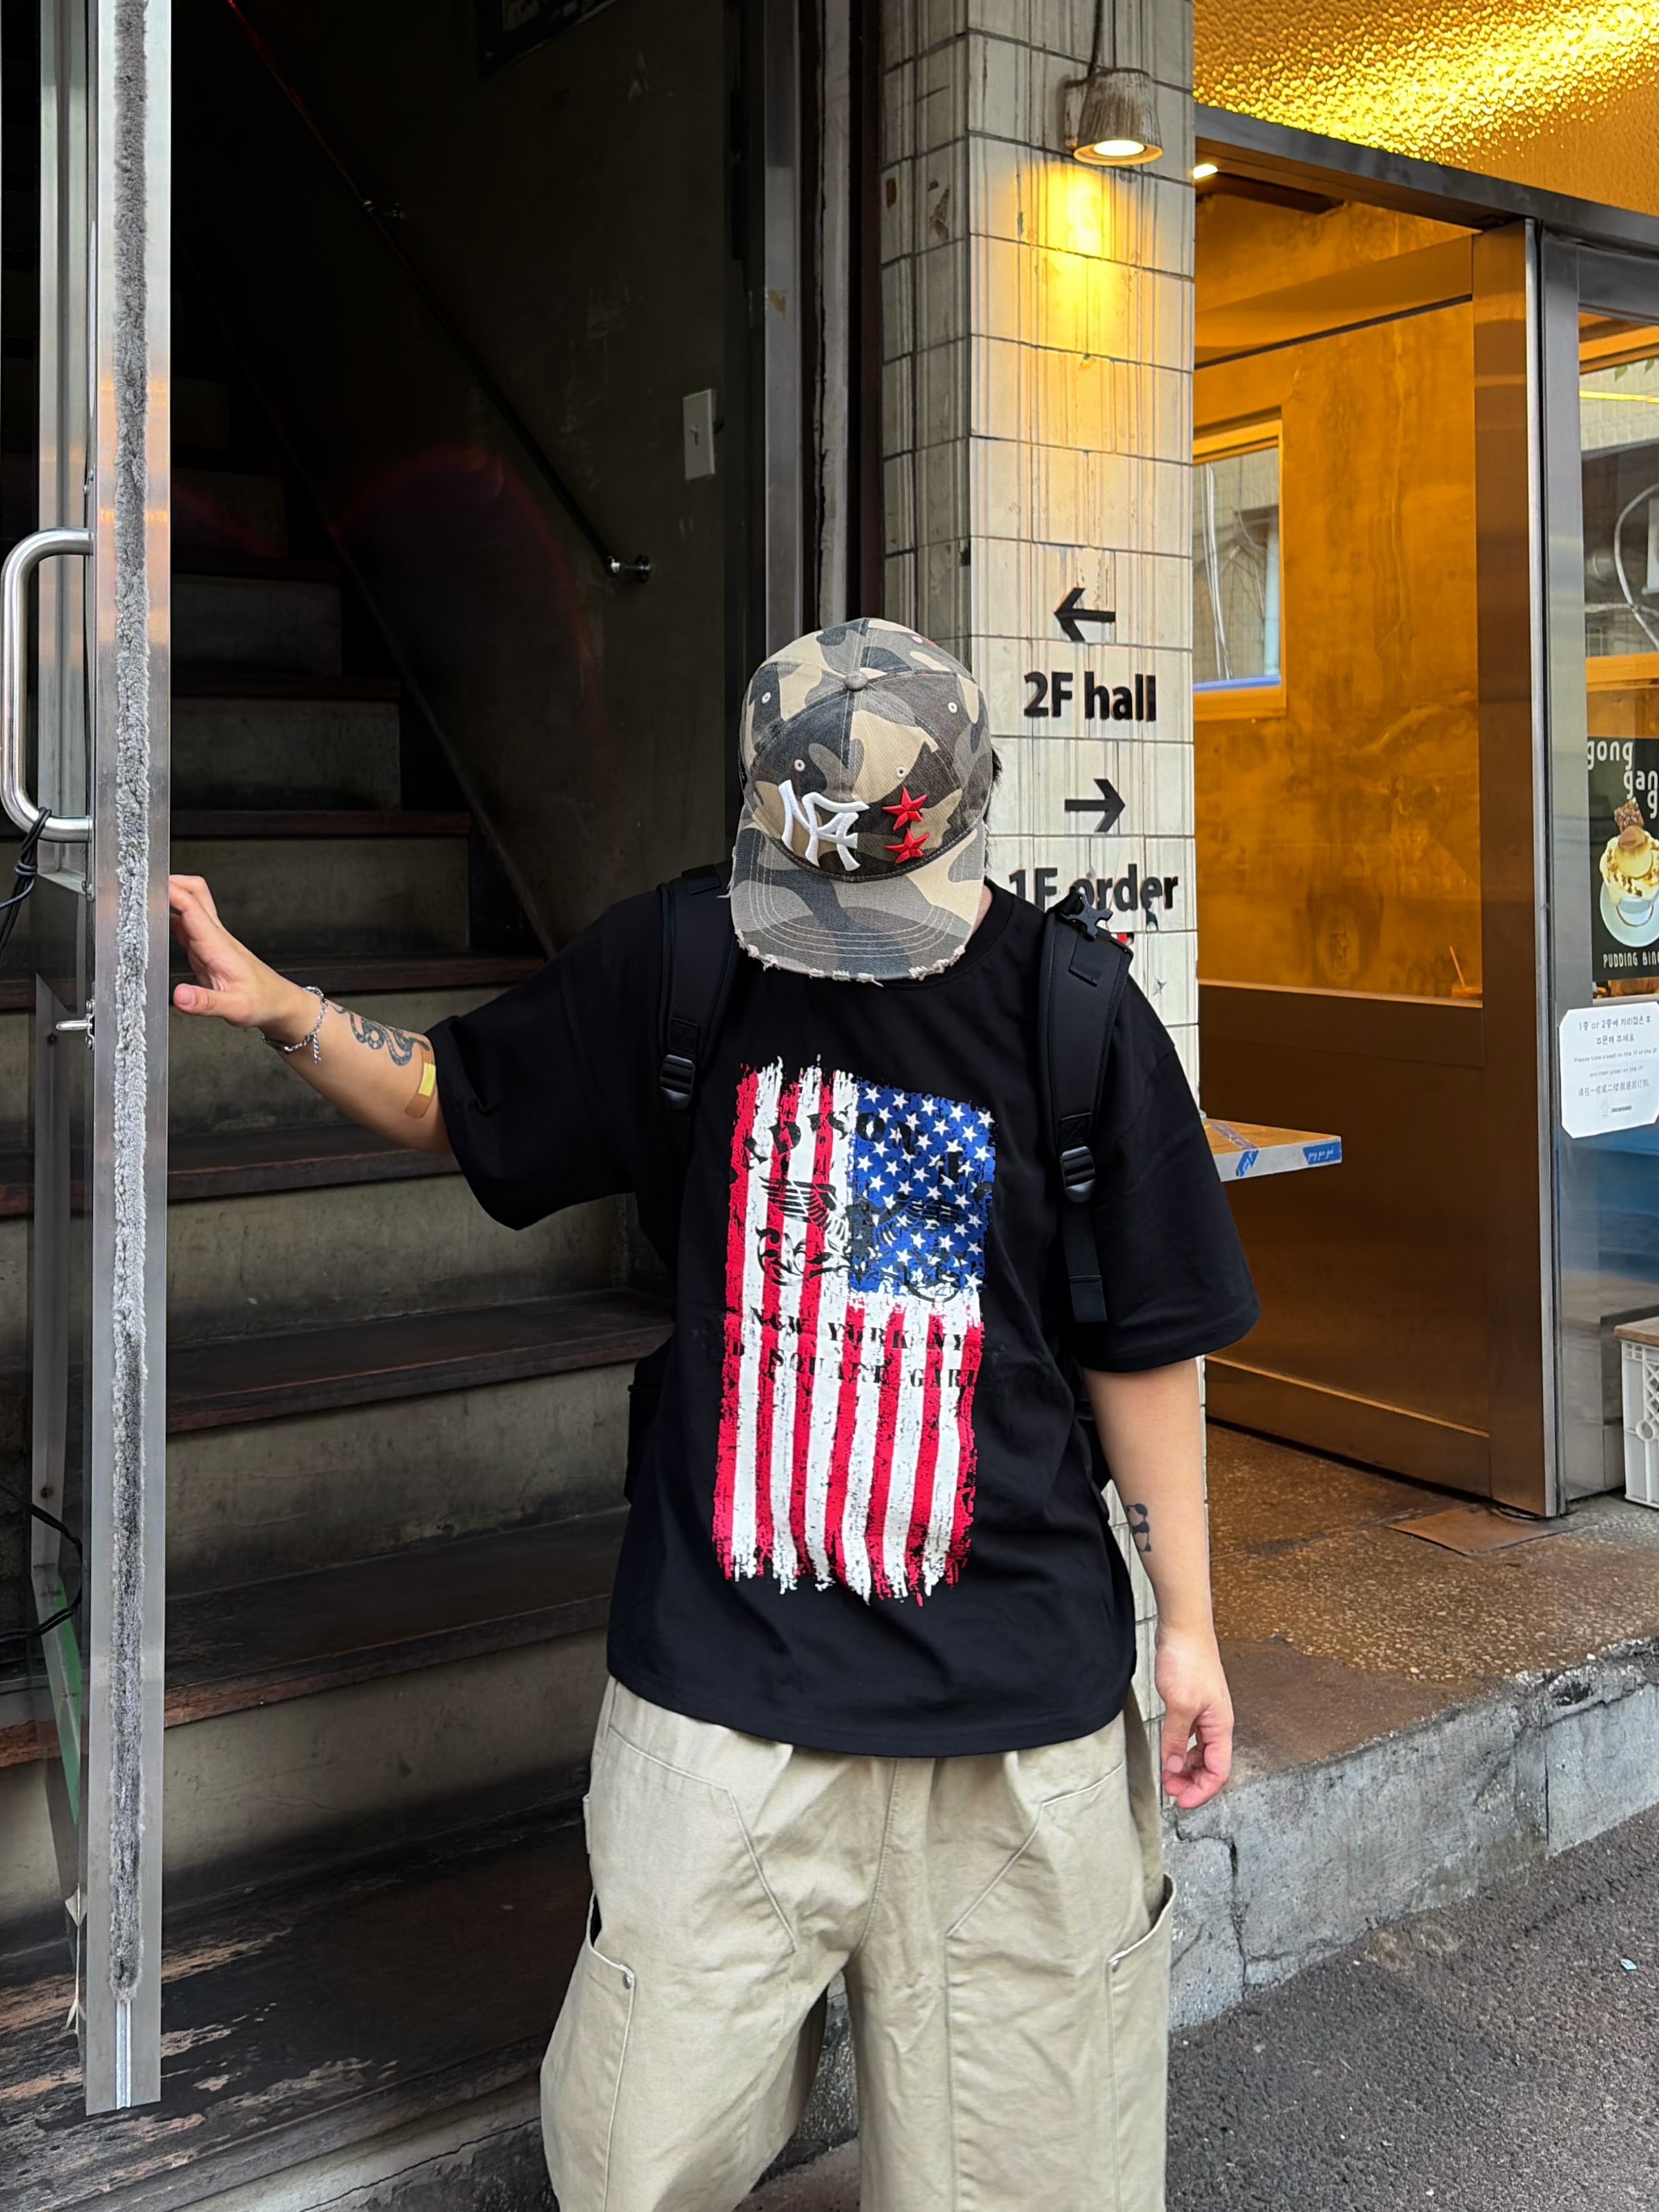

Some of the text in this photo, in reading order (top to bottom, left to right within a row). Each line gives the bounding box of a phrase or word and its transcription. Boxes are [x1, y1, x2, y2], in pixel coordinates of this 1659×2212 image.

[1023, 670, 1157, 722] 2F hall
[1587, 741, 1633, 771] gong
[1008, 862, 1179, 913] 1F order
[1603, 952, 1638, 968] PUDDING
